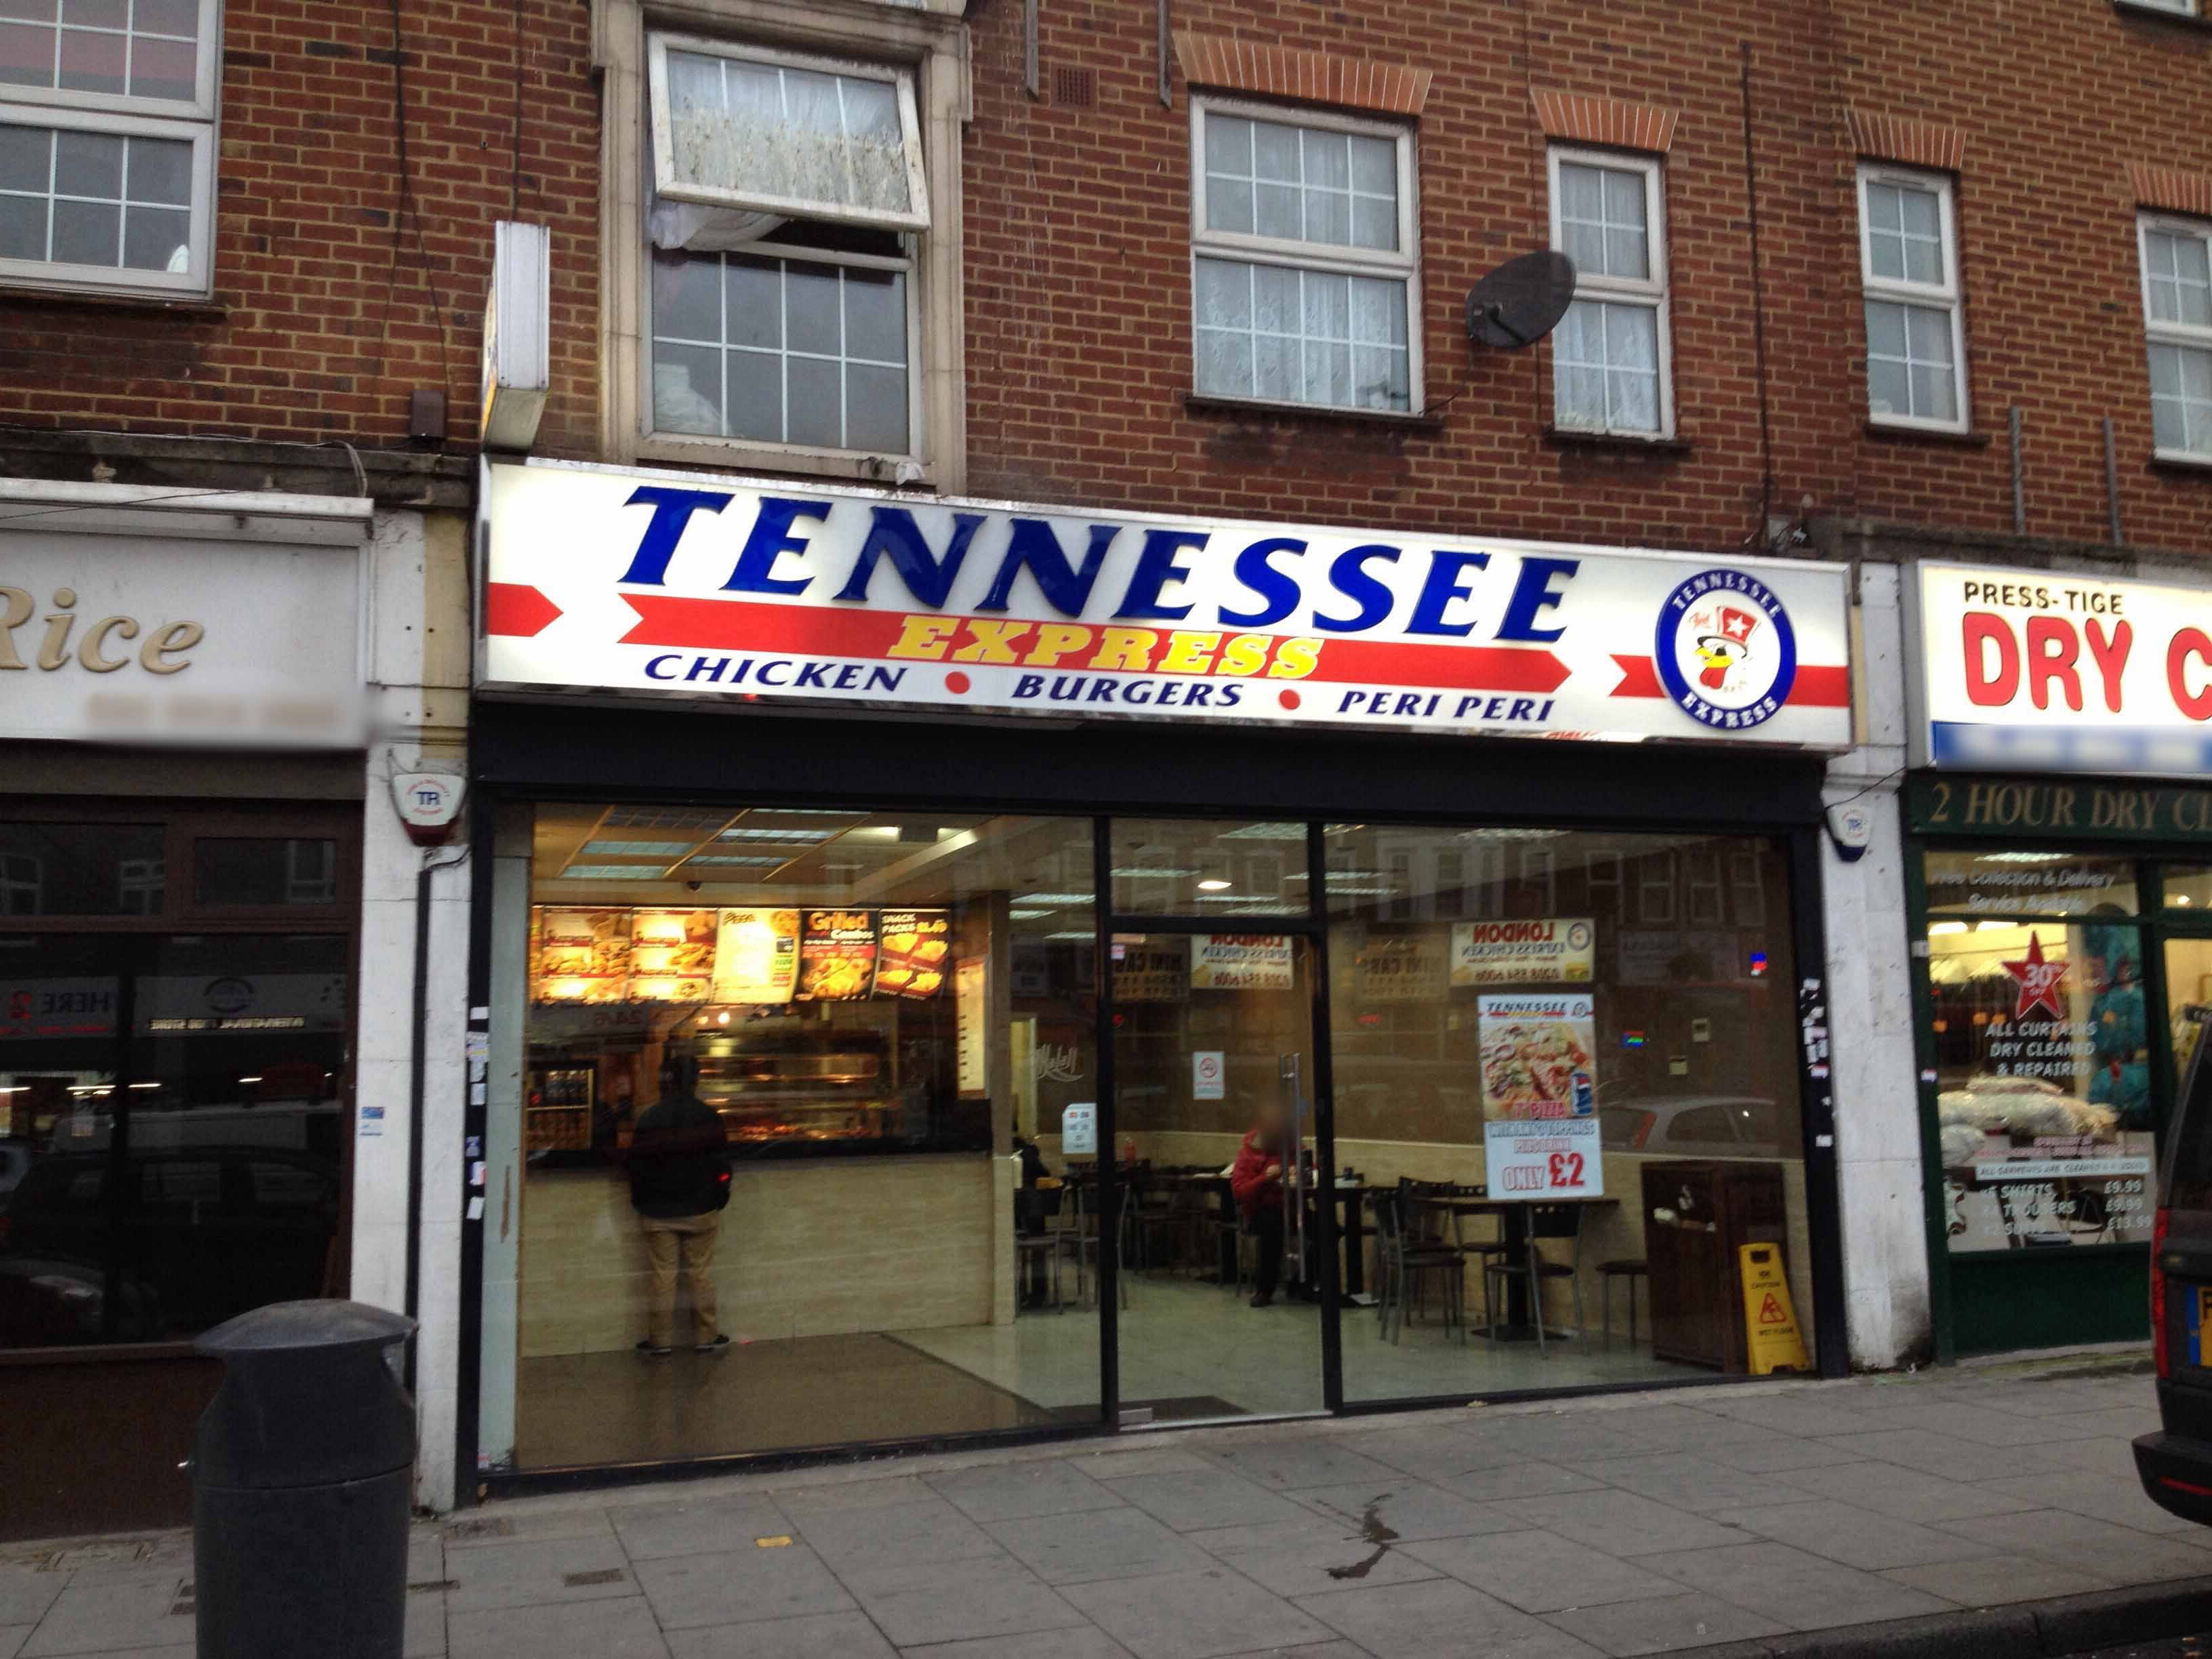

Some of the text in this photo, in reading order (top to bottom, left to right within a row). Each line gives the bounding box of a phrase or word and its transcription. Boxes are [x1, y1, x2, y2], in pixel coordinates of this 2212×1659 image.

[617, 486, 1581, 642] TENNESSEE
[1673, 573, 1782, 618] TENNESSEE
[1964, 581, 2123, 614] PRESS-TIGE
[0, 587, 203, 674] Rice
[886, 614, 1324, 679] EXPRESS
[1963, 611, 2133, 713] DRY
[644, 654, 1557, 721] CHICKEN BURGERS PERI PERI
[1681, 692, 1777, 728] EXPRESS
[1929, 782, 1951, 823] 2
[1965, 783, 2076, 826] HOUR
[2091, 789, 2160, 830] DRY
[1968, 893, 2021, 912] Service
[809, 912, 869, 930] Grilled
[1487, 1002, 1567, 1012] TENNESSEE
[1986, 1021, 2099, 1037] ALL CURTAINS
[1989, 1041, 2097, 1057] DRY CLEANED
[1996, 1061, 2092, 1077] & REPAIRED
[1502, 1152, 1585, 1191] ONLY £2
[2104, 1179, 2143, 1194] £9.99
